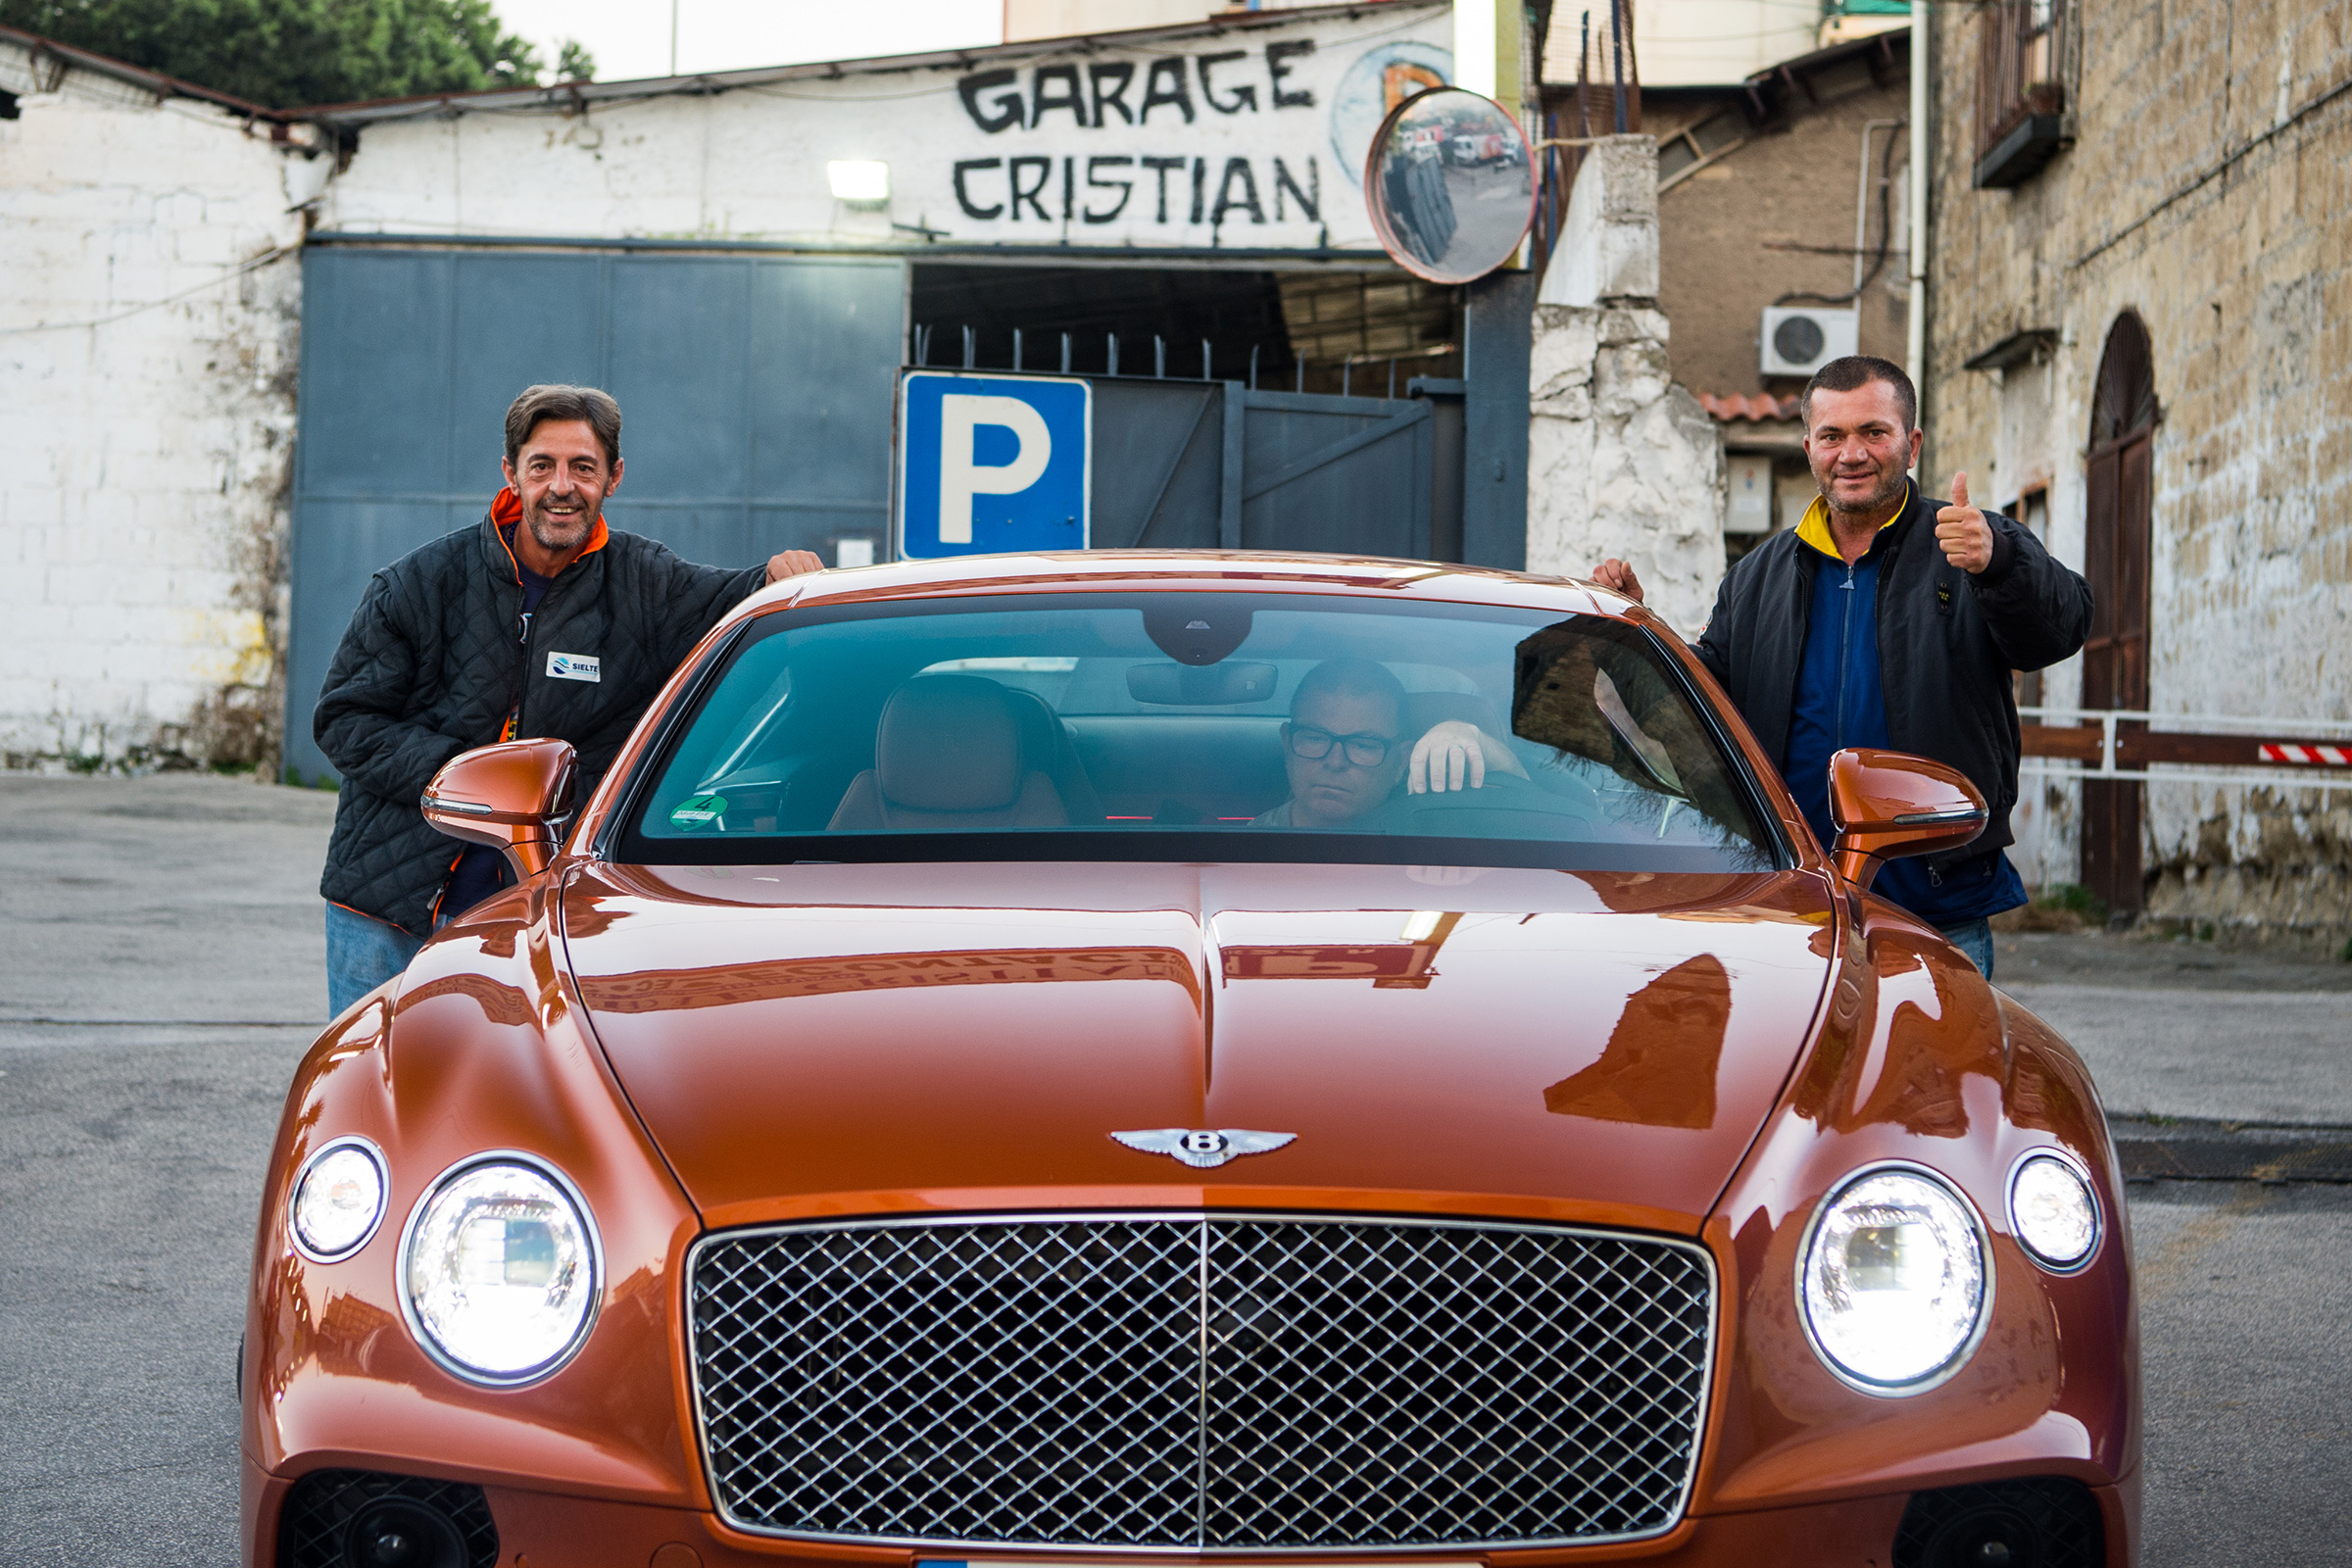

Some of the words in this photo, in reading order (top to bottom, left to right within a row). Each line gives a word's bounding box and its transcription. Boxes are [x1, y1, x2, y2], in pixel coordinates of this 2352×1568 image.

[958, 39, 1316, 133] GARAGE
[954, 156, 1318, 223] CRISTIAN
[939, 394, 1052, 544] P
[572, 662, 599, 673] SIELTE
[695, 796, 715, 811] 4
[1187, 1130, 1221, 1153] B
